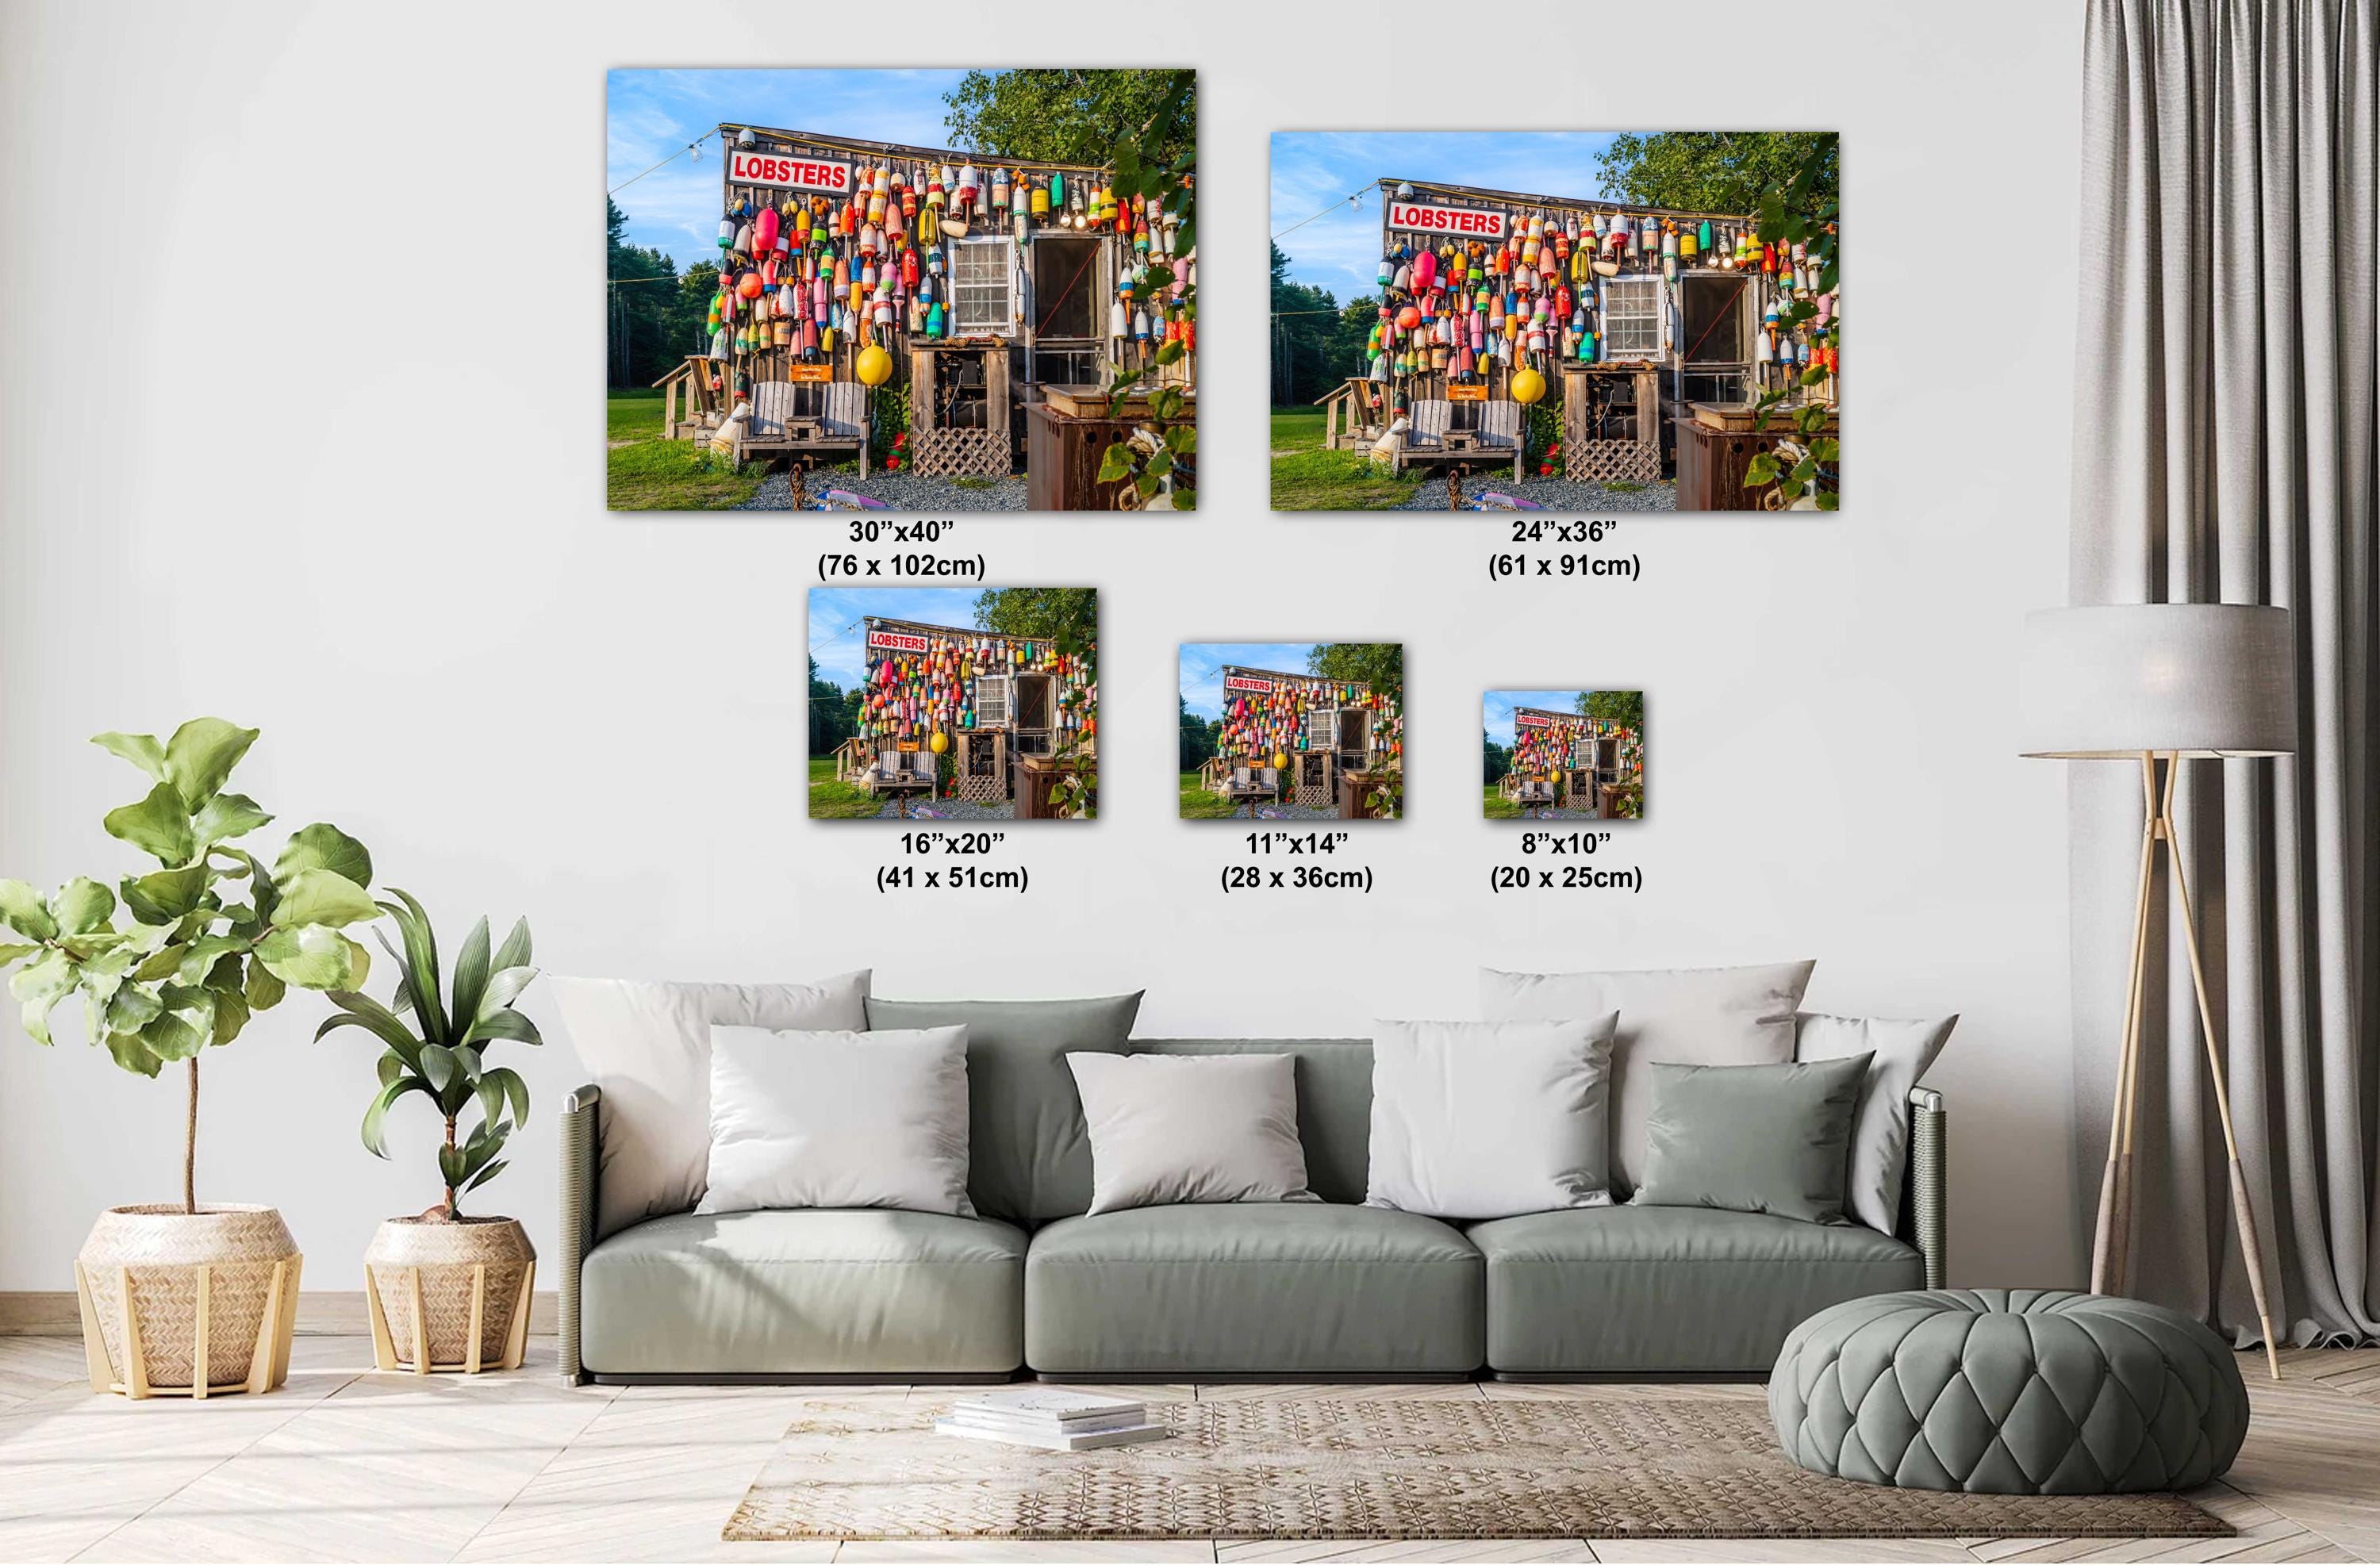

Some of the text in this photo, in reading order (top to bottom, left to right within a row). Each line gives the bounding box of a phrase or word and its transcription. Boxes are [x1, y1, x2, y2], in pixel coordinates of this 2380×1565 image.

[735, 155, 846, 188] LOBSTERS
[1393, 205, 1501, 234] LOBSTERS
[870, 633, 926, 650] LOBSTERS
[1226, 677, 1270, 691] LOBSTERS
[1517, 715, 1549, 726] LOBSTERS
